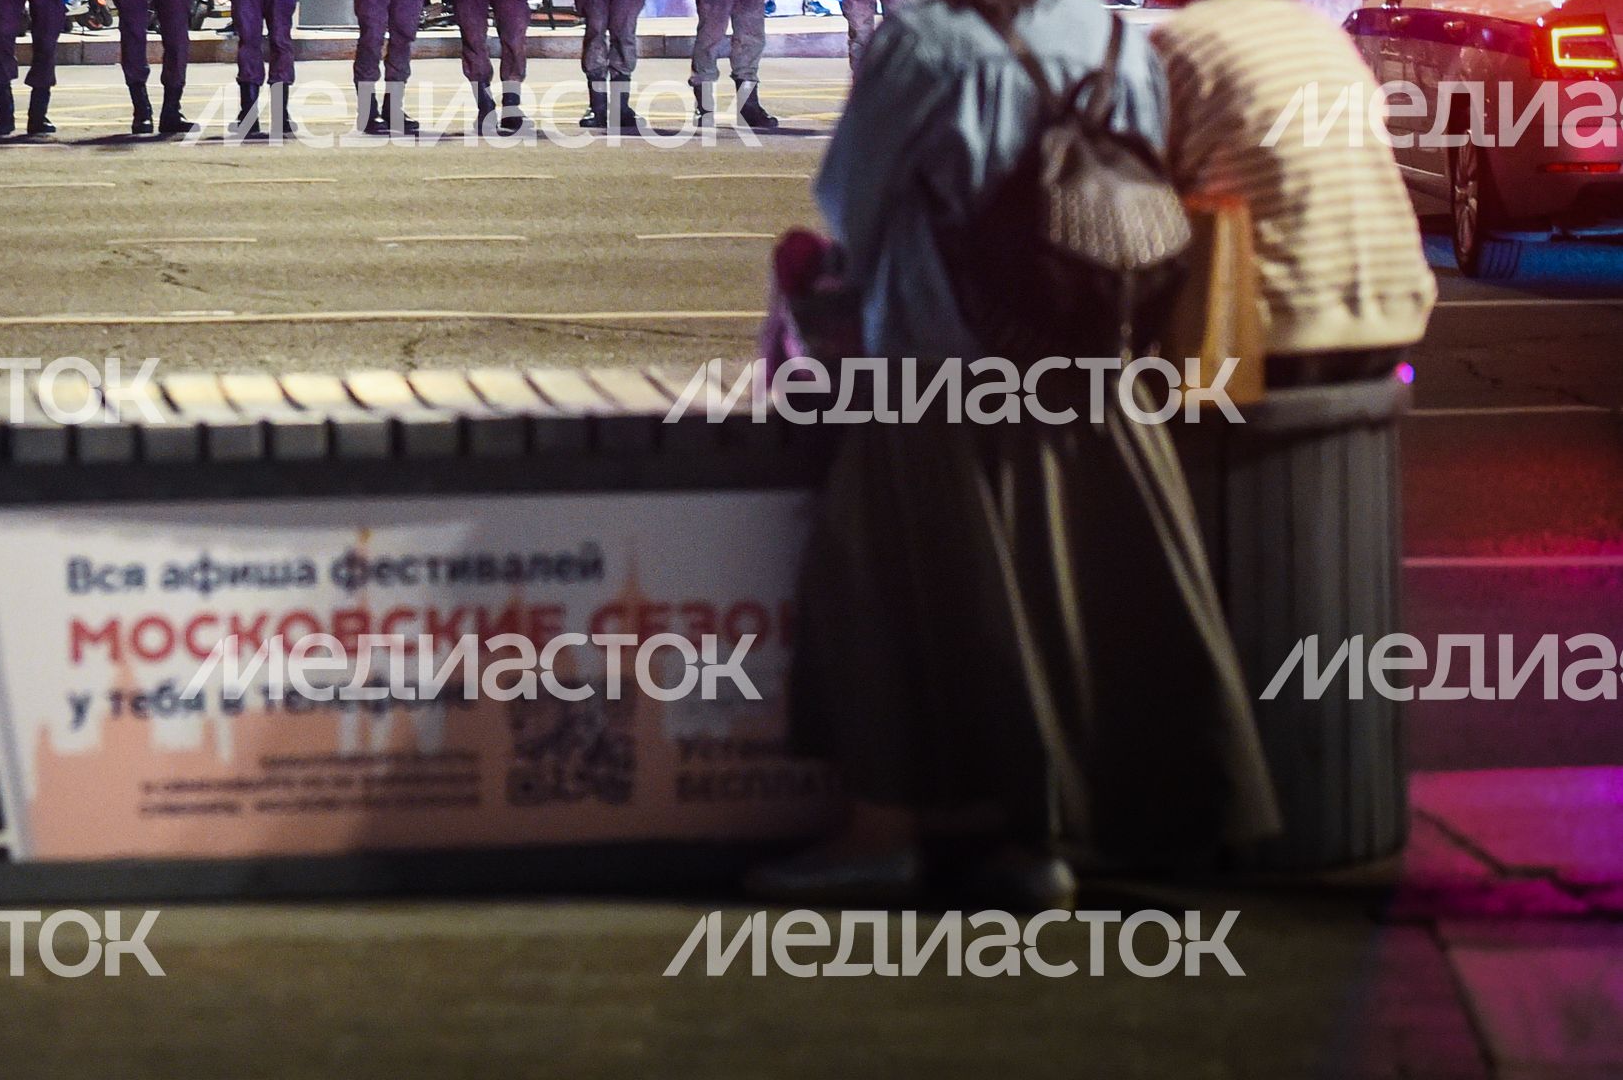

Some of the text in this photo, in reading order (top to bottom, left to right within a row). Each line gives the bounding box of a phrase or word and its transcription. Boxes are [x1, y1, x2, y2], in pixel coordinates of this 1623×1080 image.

[66, 542, 605, 598] Вся афиша фестивалей
[69, 602, 567, 664] МОСКОВСКИЕ
